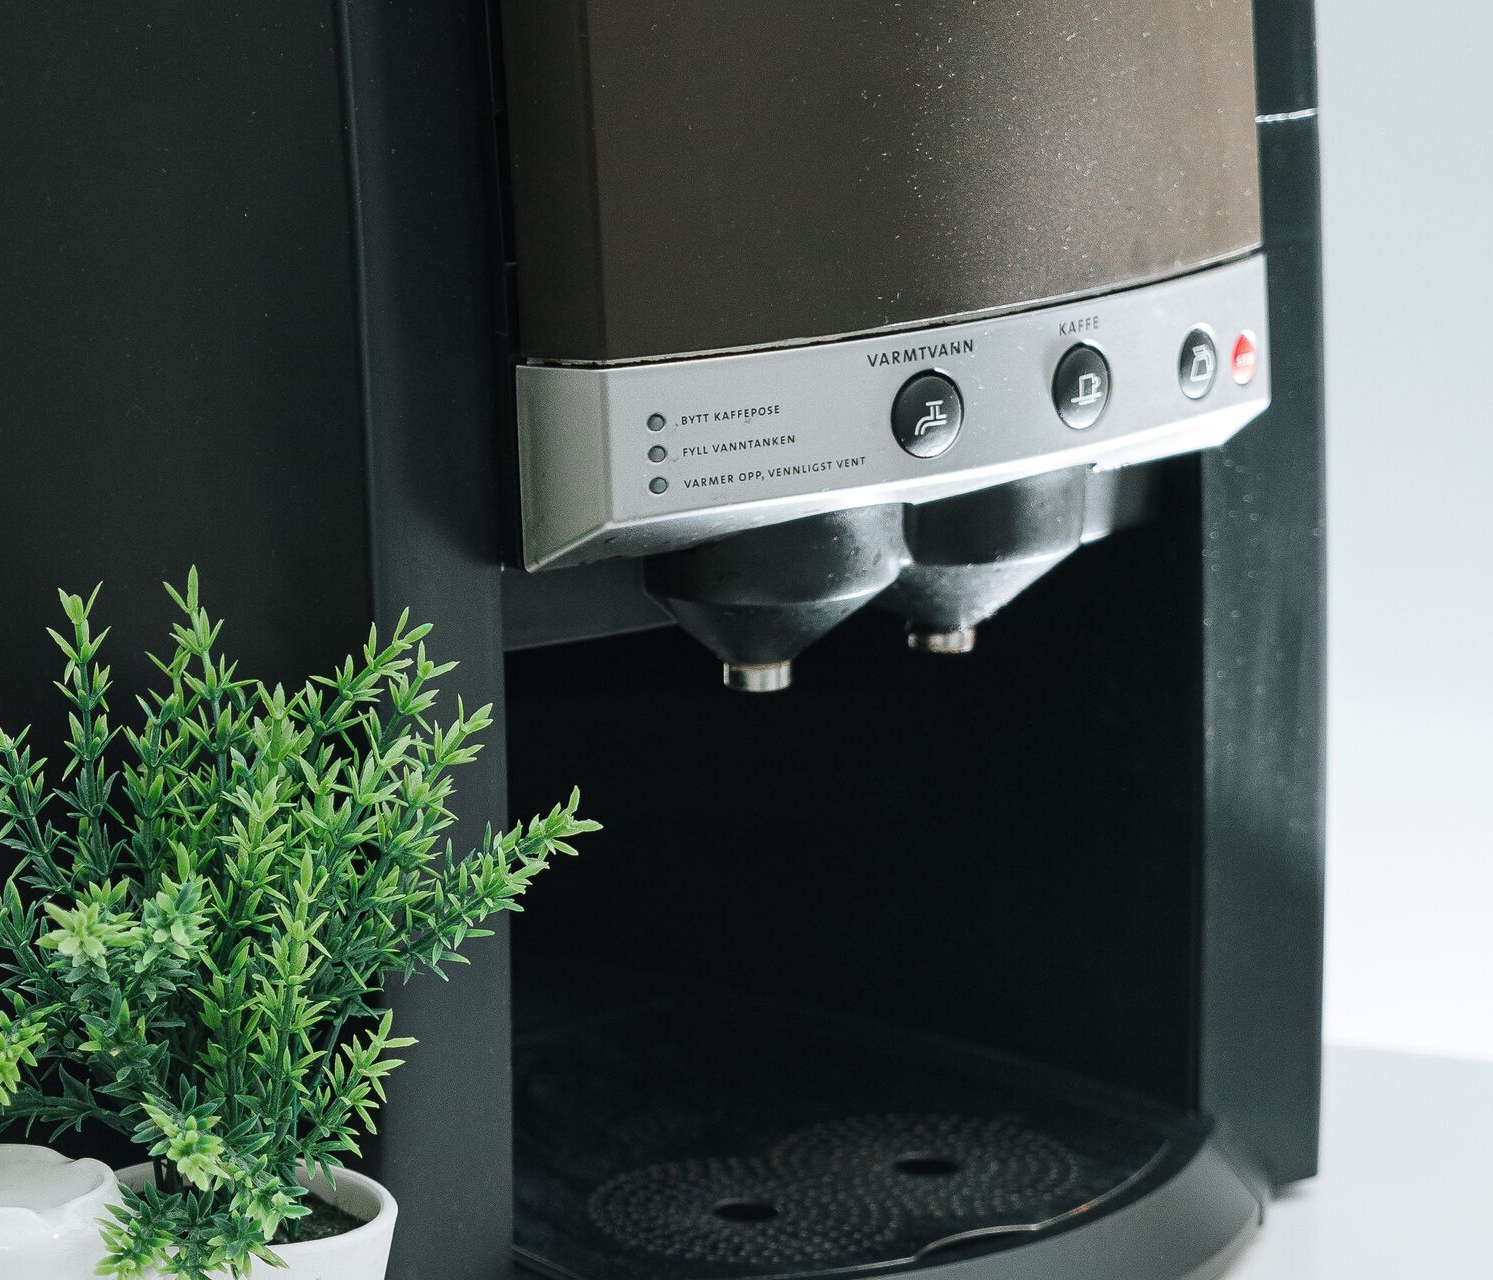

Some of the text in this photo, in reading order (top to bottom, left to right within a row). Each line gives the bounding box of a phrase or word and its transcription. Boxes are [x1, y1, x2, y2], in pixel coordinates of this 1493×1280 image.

[1058, 316, 1100, 336] KAFFE
[867, 339, 974, 368] VARMTVANN
[681, 405, 781, 426] BYTT KAFFEPOSE
[682, 434, 795, 457] FYLL VANNTANKEN
[684, 456, 866, 489] VARMER OPP, VENNLIGST VENT
